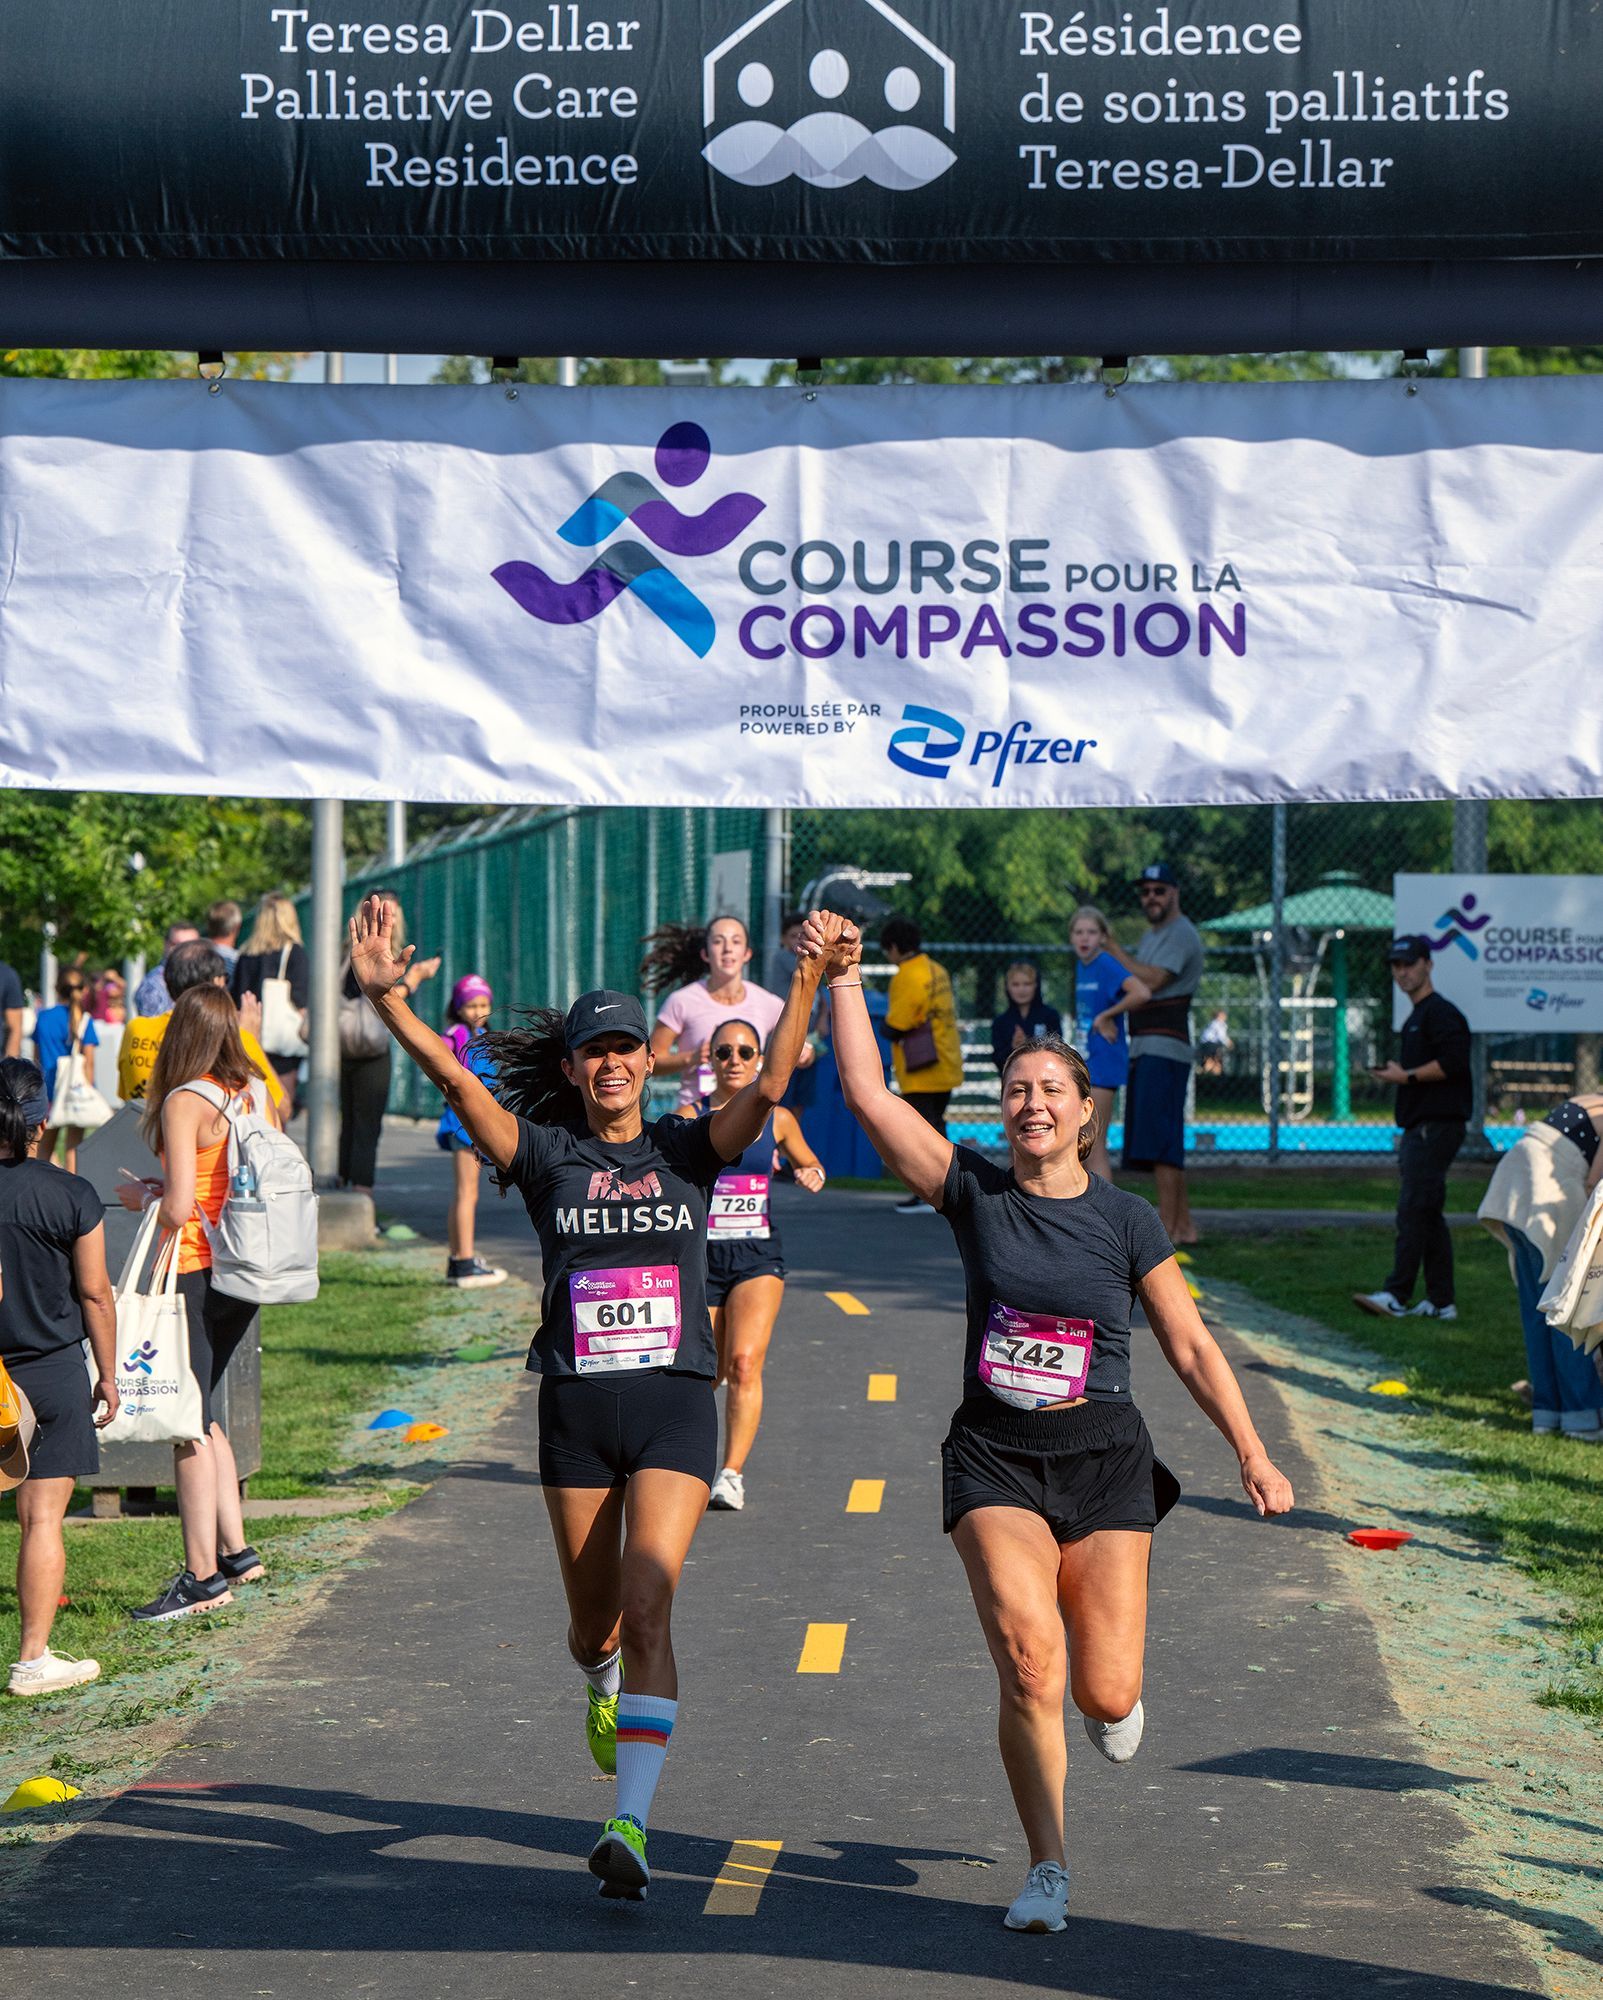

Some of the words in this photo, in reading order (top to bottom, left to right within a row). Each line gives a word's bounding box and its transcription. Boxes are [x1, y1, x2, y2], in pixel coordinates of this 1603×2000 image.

[271, 9, 451, 54] Teresa
[471, 4, 640, 53] Dellar
[1020, 7, 1301, 56] Résidence
[241, 70, 492, 120] Palliative
[514, 73, 637, 119] Care
[1020, 73, 1083, 123] de
[1104, 78, 1246, 123] soins
[1266, 70, 1509, 133] palliatifs
[365, 137, 637, 186] Residence
[1020, 139, 1393, 189] Teresa-Dellar
[738, 538, 1051, 596] COURSE
[1065, 562, 1178, 593] POUR
[1191, 563, 1242, 593] LA
[738, 602, 1247, 660] COMPASSION
[739, 701, 842, 719] PROPULSÉE
[847, 703, 882, 717] PAR
[740, 721, 829, 736] POWERED
[833, 721, 856, 734] BY
[969, 720, 1098, 788] Pfizer
[1484, 928, 1572, 945] COURSE
[555, 1204, 694, 1235] MELISSA
[722, 1197, 756, 1212] 726
[641, 1272, 653, 1289] 5
[655, 1278, 673, 1288] km
[596, 1301, 653, 1328] 601
[1055, 1321, 1067, 1335] 5
[1069, 1327, 1087, 1338] km
[1006, 1339, 1064, 1370] 742
[114, 1377, 148, 1386] OURSE
[117, 1386, 178, 1396] MPASSION
